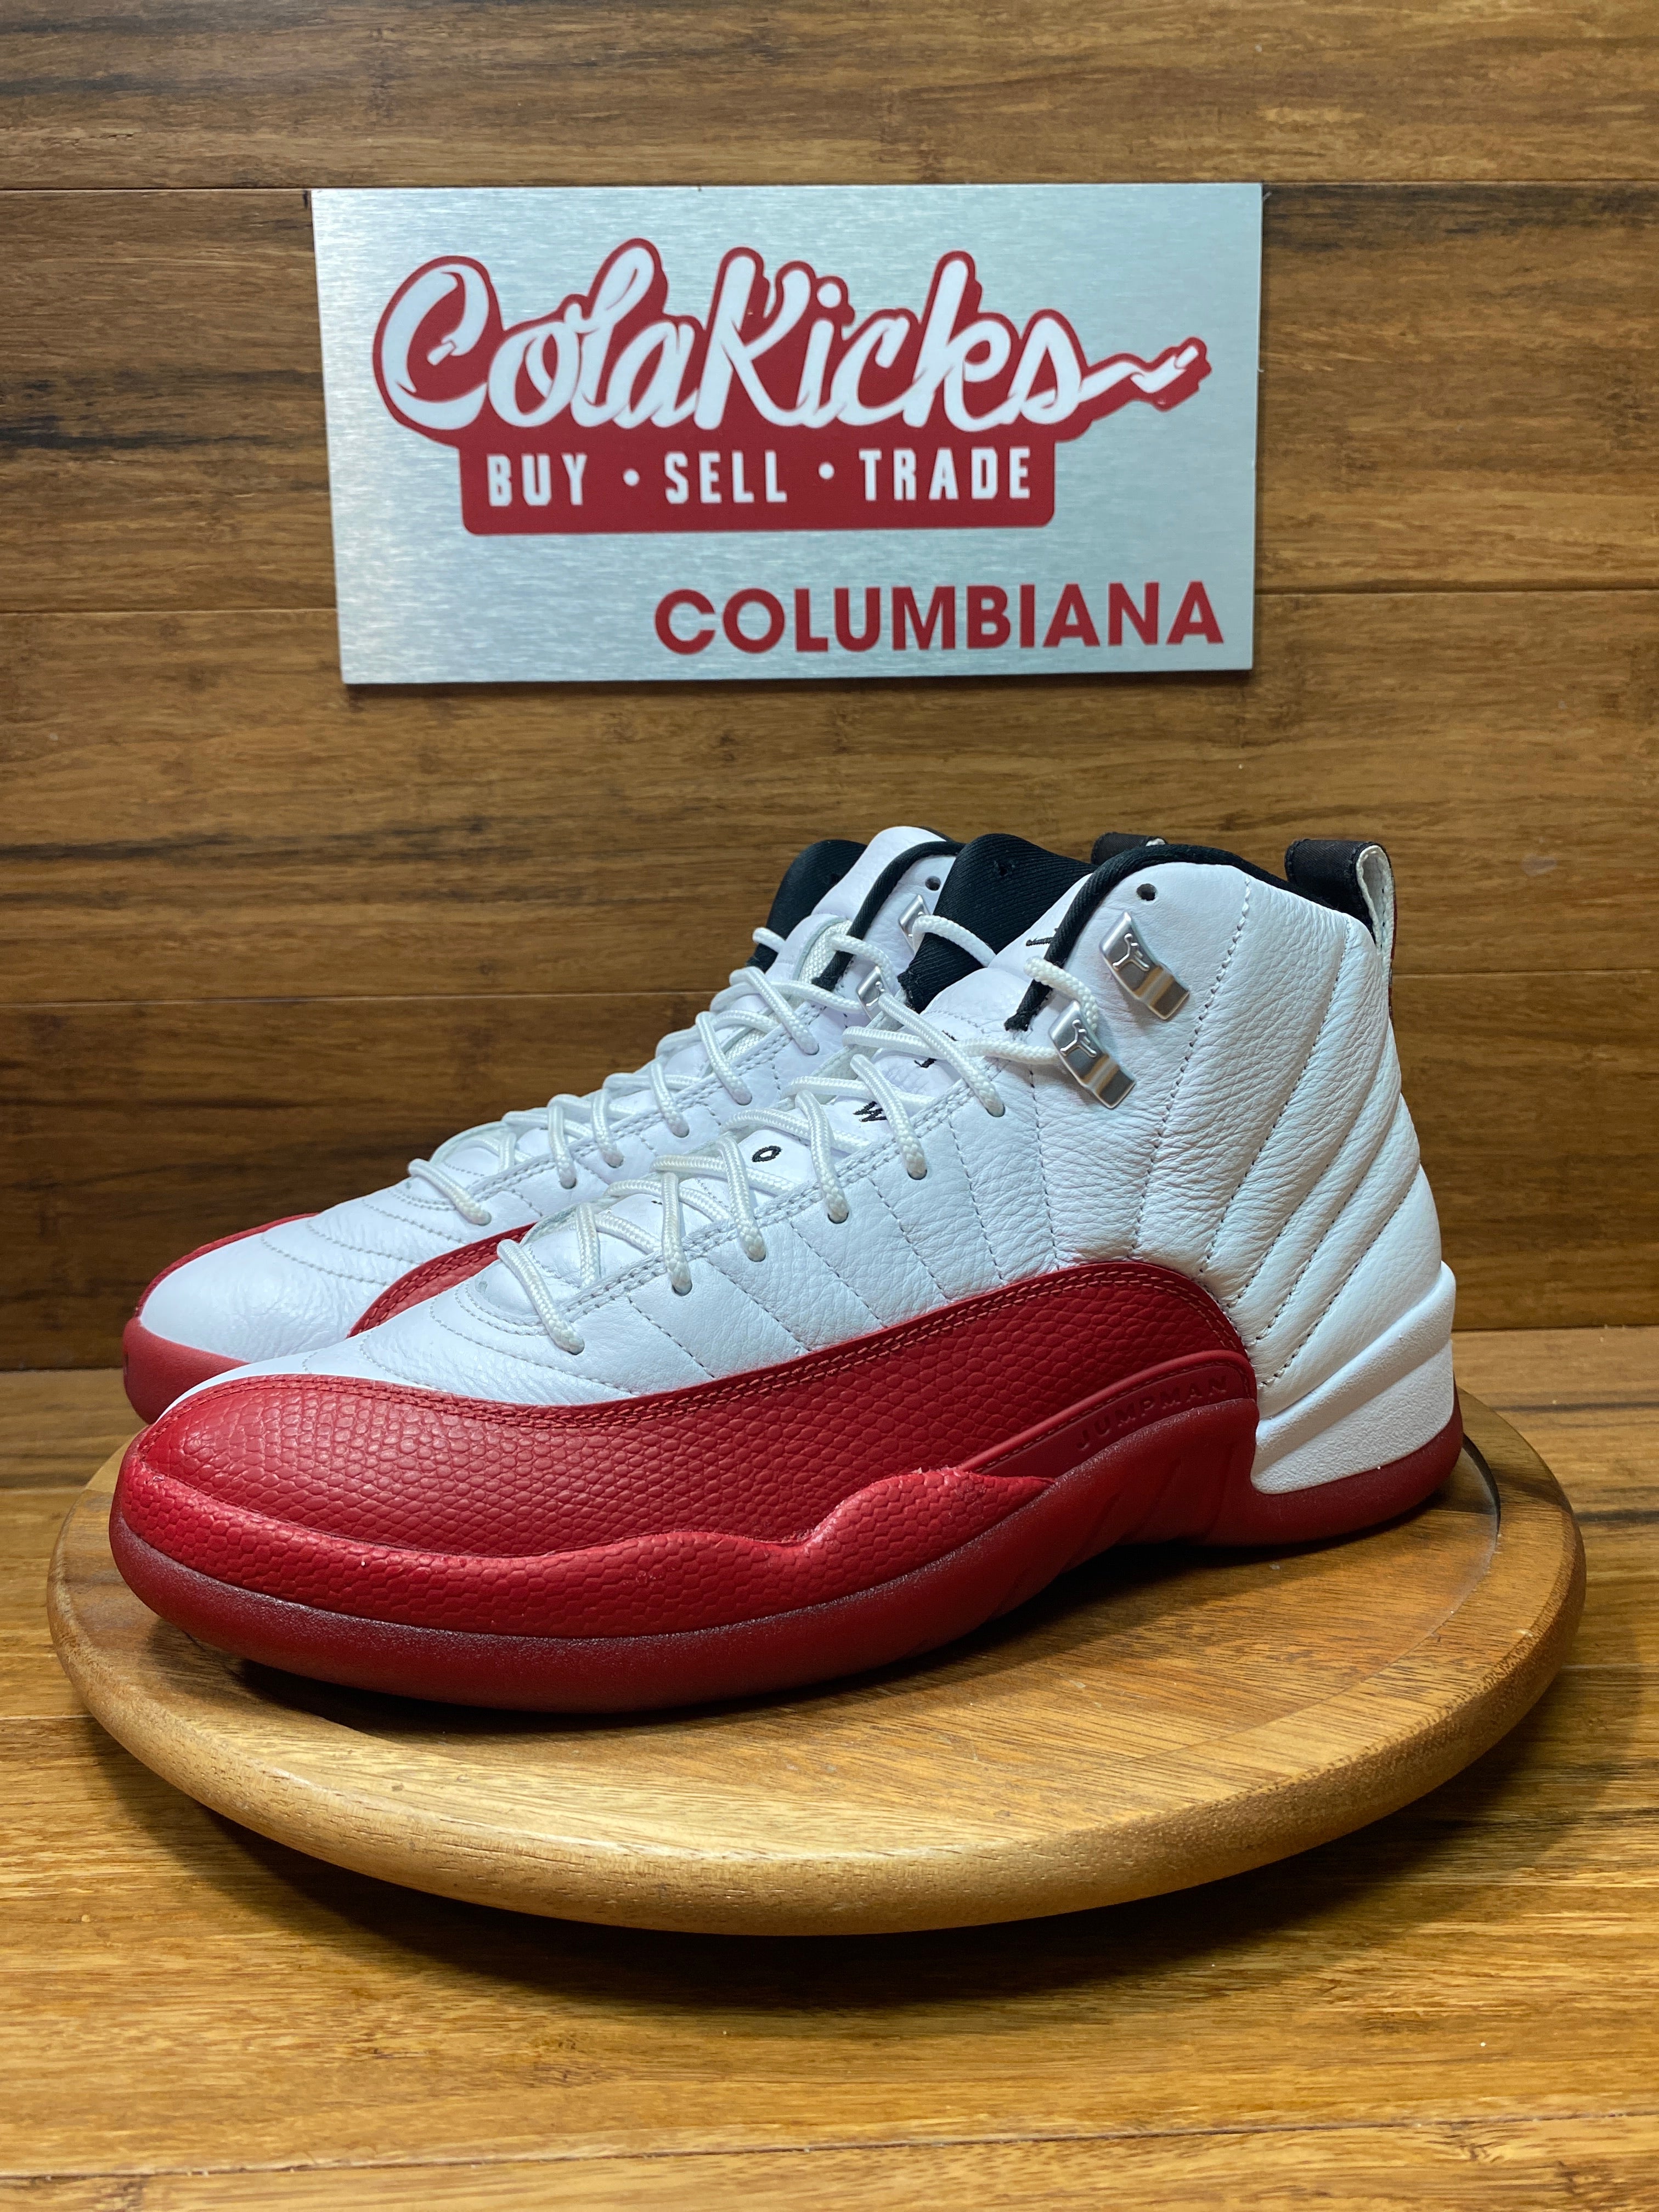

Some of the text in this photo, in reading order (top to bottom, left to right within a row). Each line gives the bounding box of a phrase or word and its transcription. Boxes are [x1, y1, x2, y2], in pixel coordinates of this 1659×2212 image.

[487, 445, 1031, 507] BUY SELL TRADE
[655, 582, 1223, 654] COLUMBIANA
[1076, 1375, 1227, 1451] JUMPMAN
